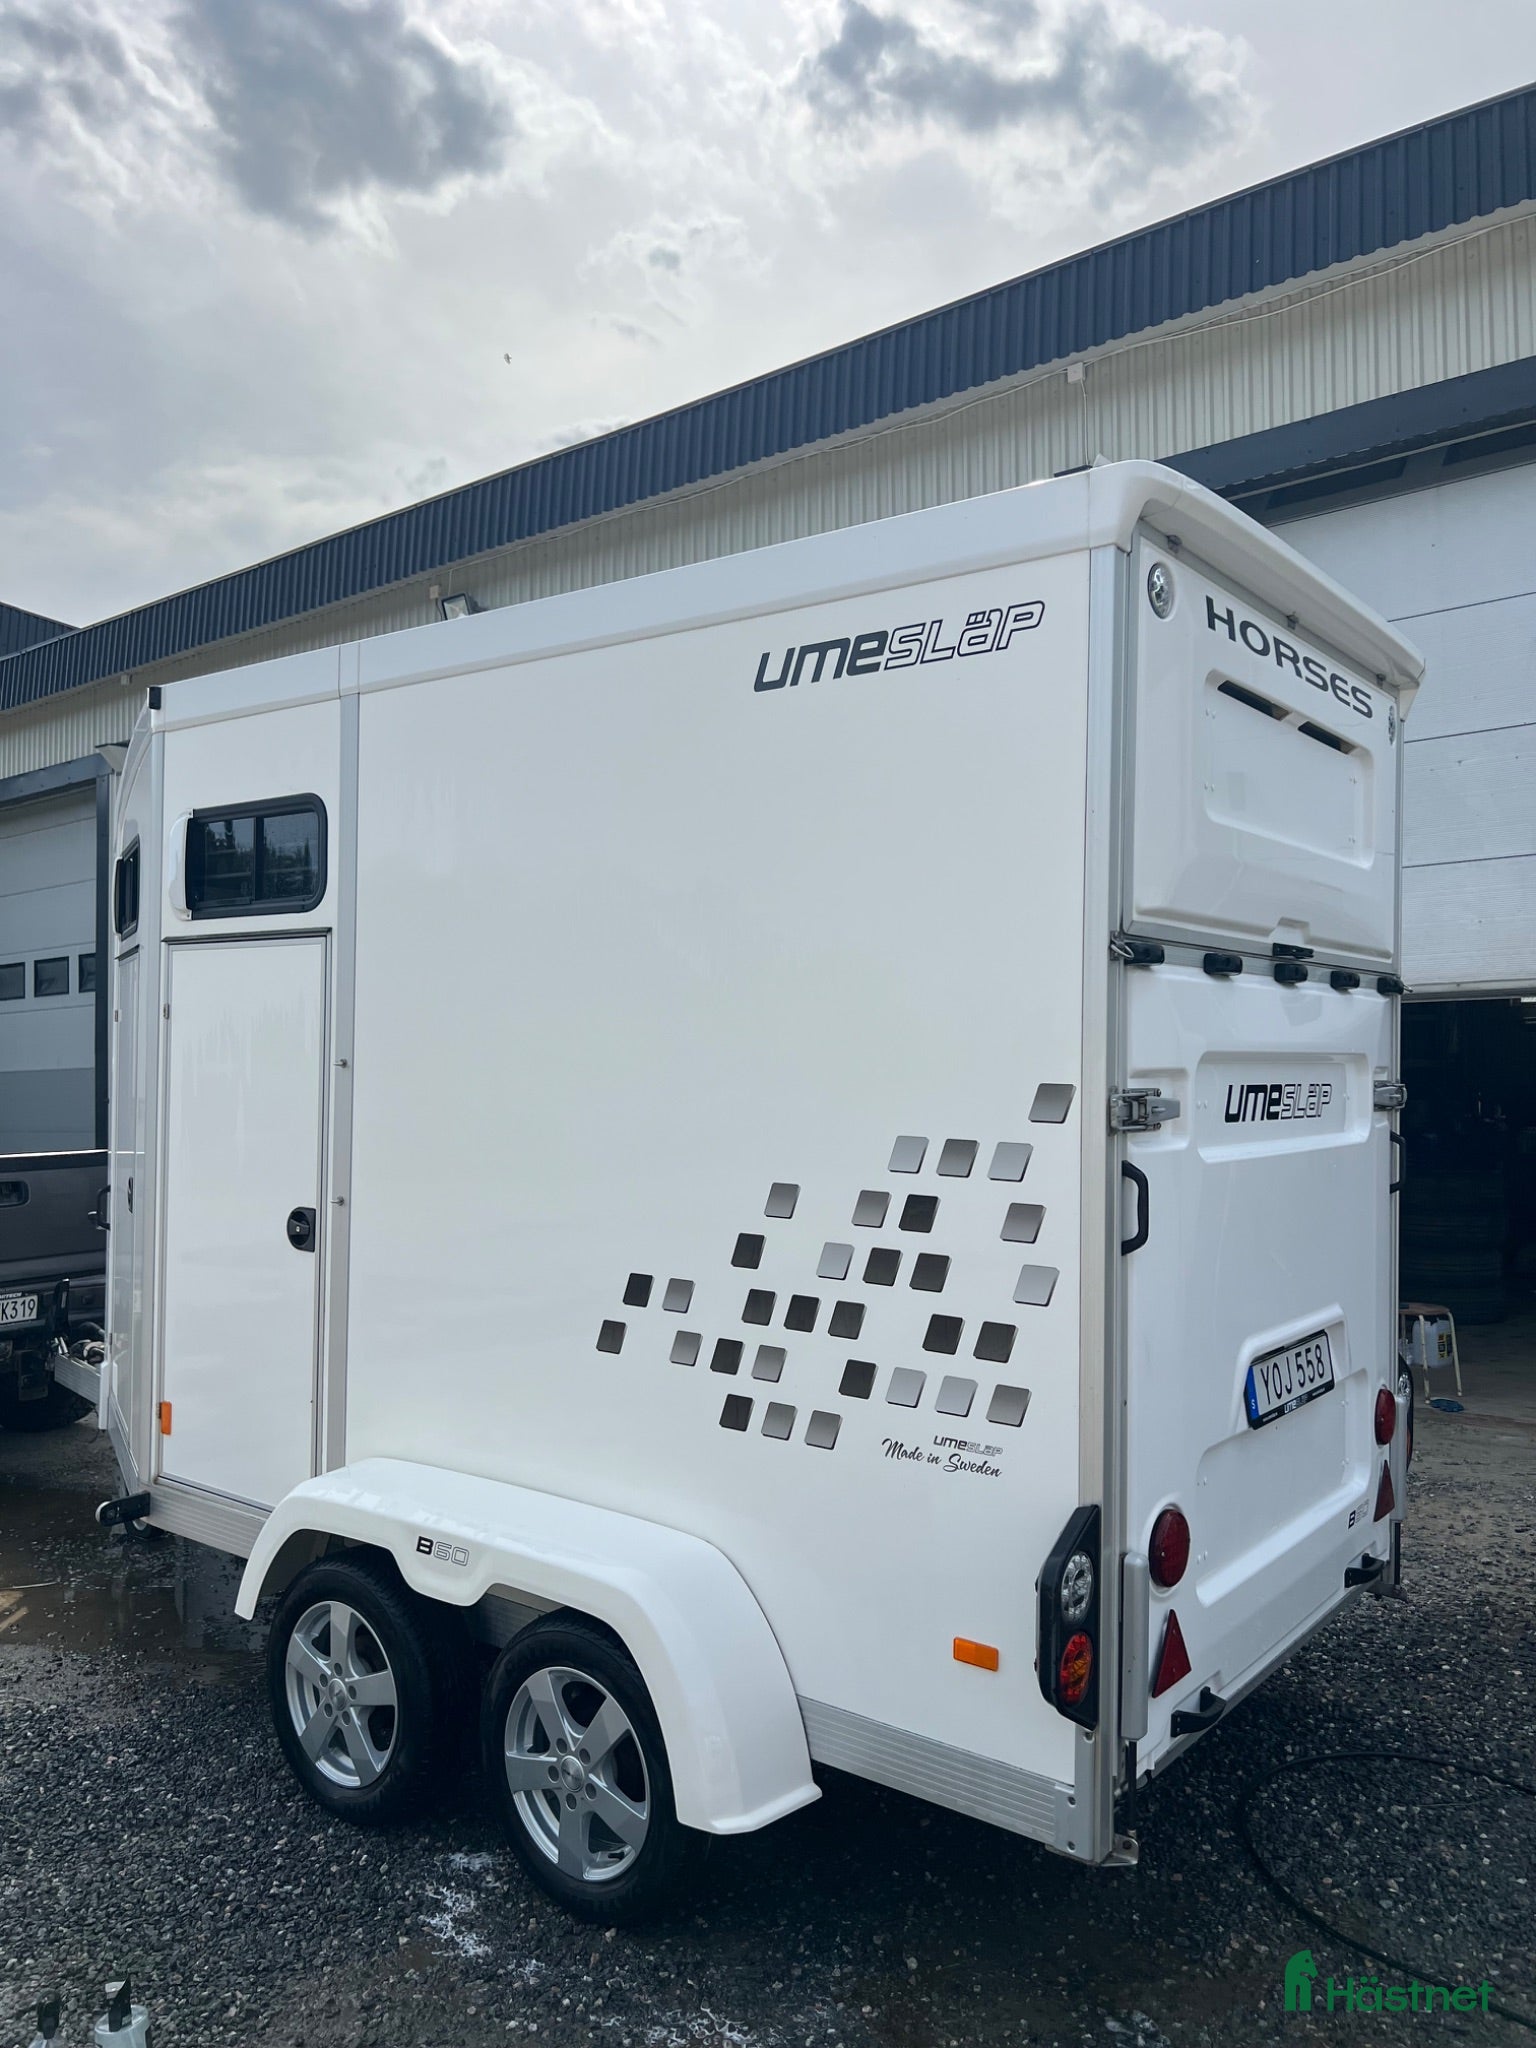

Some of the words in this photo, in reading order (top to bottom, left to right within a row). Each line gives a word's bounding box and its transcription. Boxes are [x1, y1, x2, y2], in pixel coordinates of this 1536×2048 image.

[1205, 595, 1373, 719] HORSES
[1260, 1356, 1293, 1406] YOJ
[1295, 1344, 1325, 1388] 558
[881, 1438, 925, 1461] Made
[926, 1452, 942, 1465] in
[942, 1453, 1002, 1477] Sweden
[416, 1535, 470, 1567] B60
